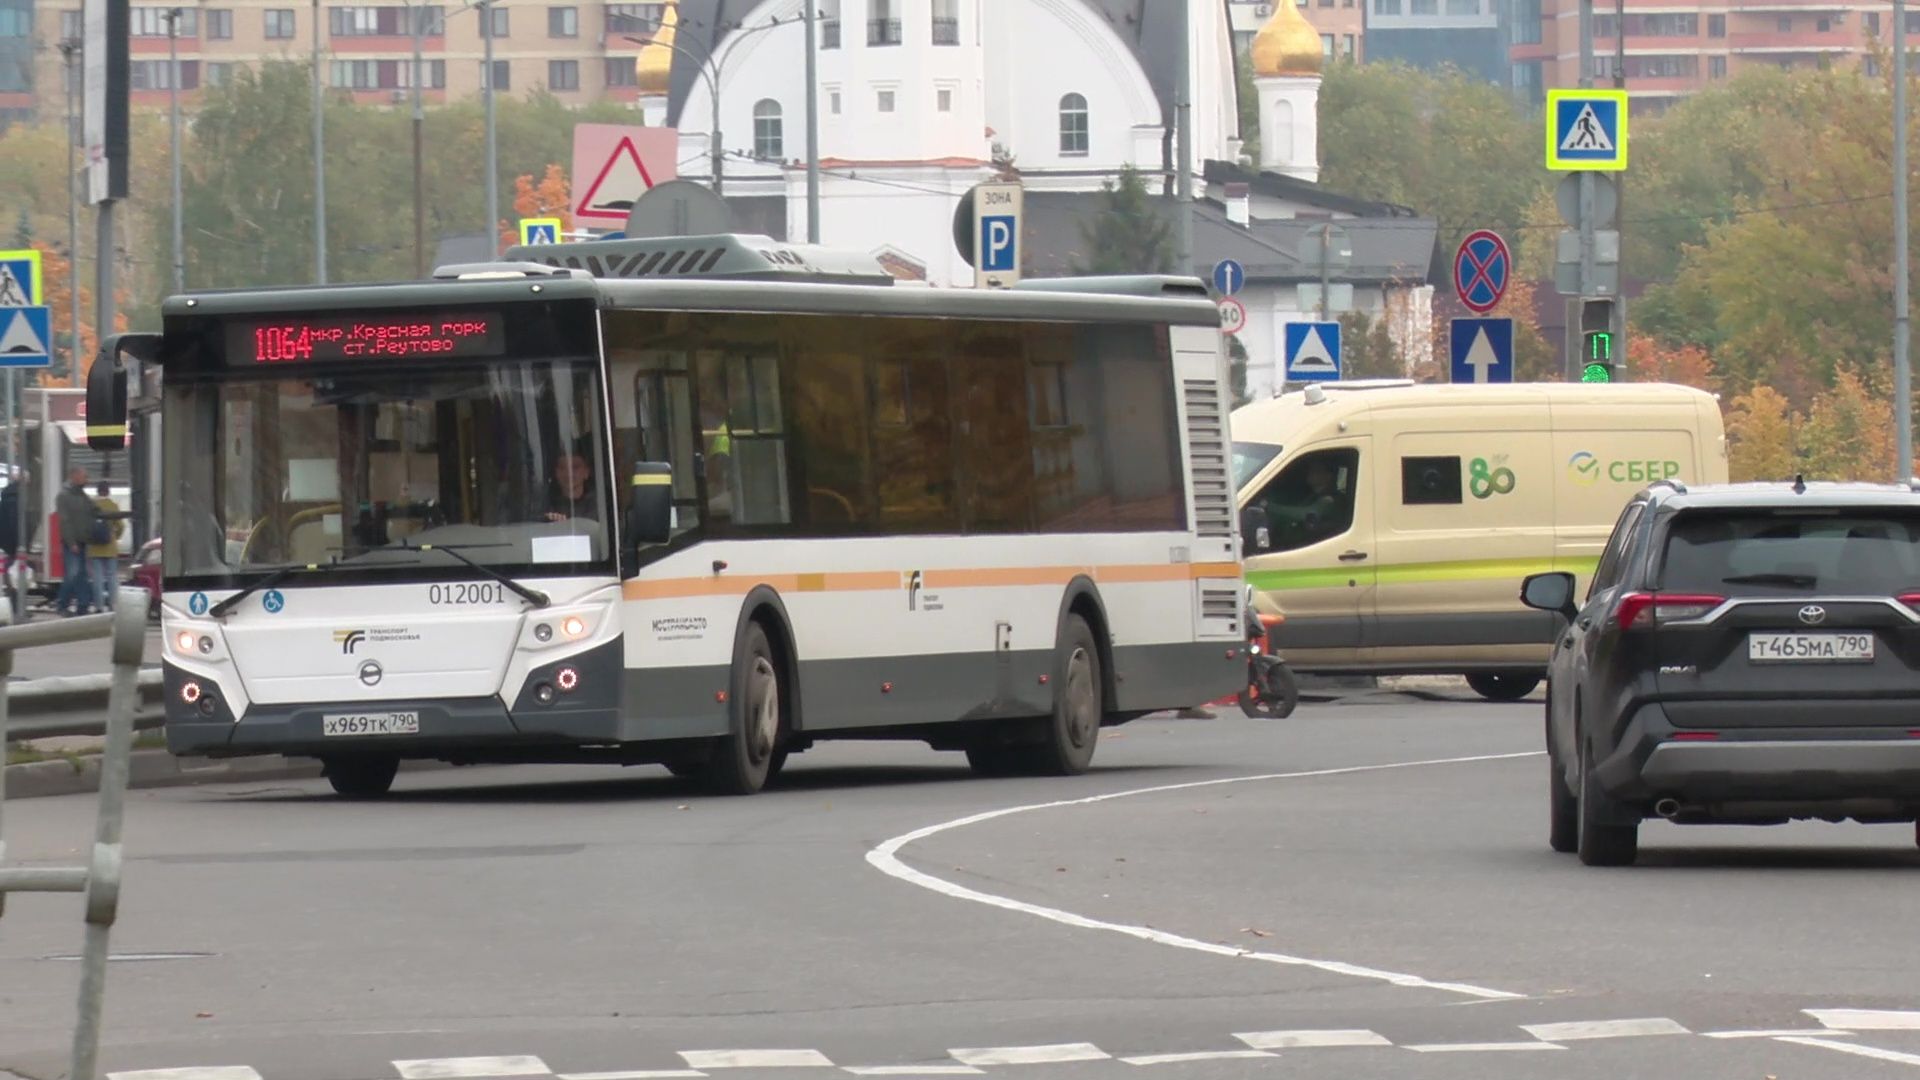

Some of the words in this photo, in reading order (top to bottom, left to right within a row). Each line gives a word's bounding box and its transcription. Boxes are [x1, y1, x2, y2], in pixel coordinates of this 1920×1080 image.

[984, 191, 1012, 204] ЗОНА
[989, 221, 1009, 266] P
[441, 322, 486, 336] горк
[255, 326, 312, 361] 1064
[343, 338, 454, 355] ст.Реутово
[1592, 333, 1609, 359] 17
[1608, 460, 1680, 482] СБЕР
[429, 583, 505, 605] 012001
[1756, 636, 1835, 657] Т465МА
[1837, 636, 1869, 651] 790
[390, 713, 414, 726] 790
